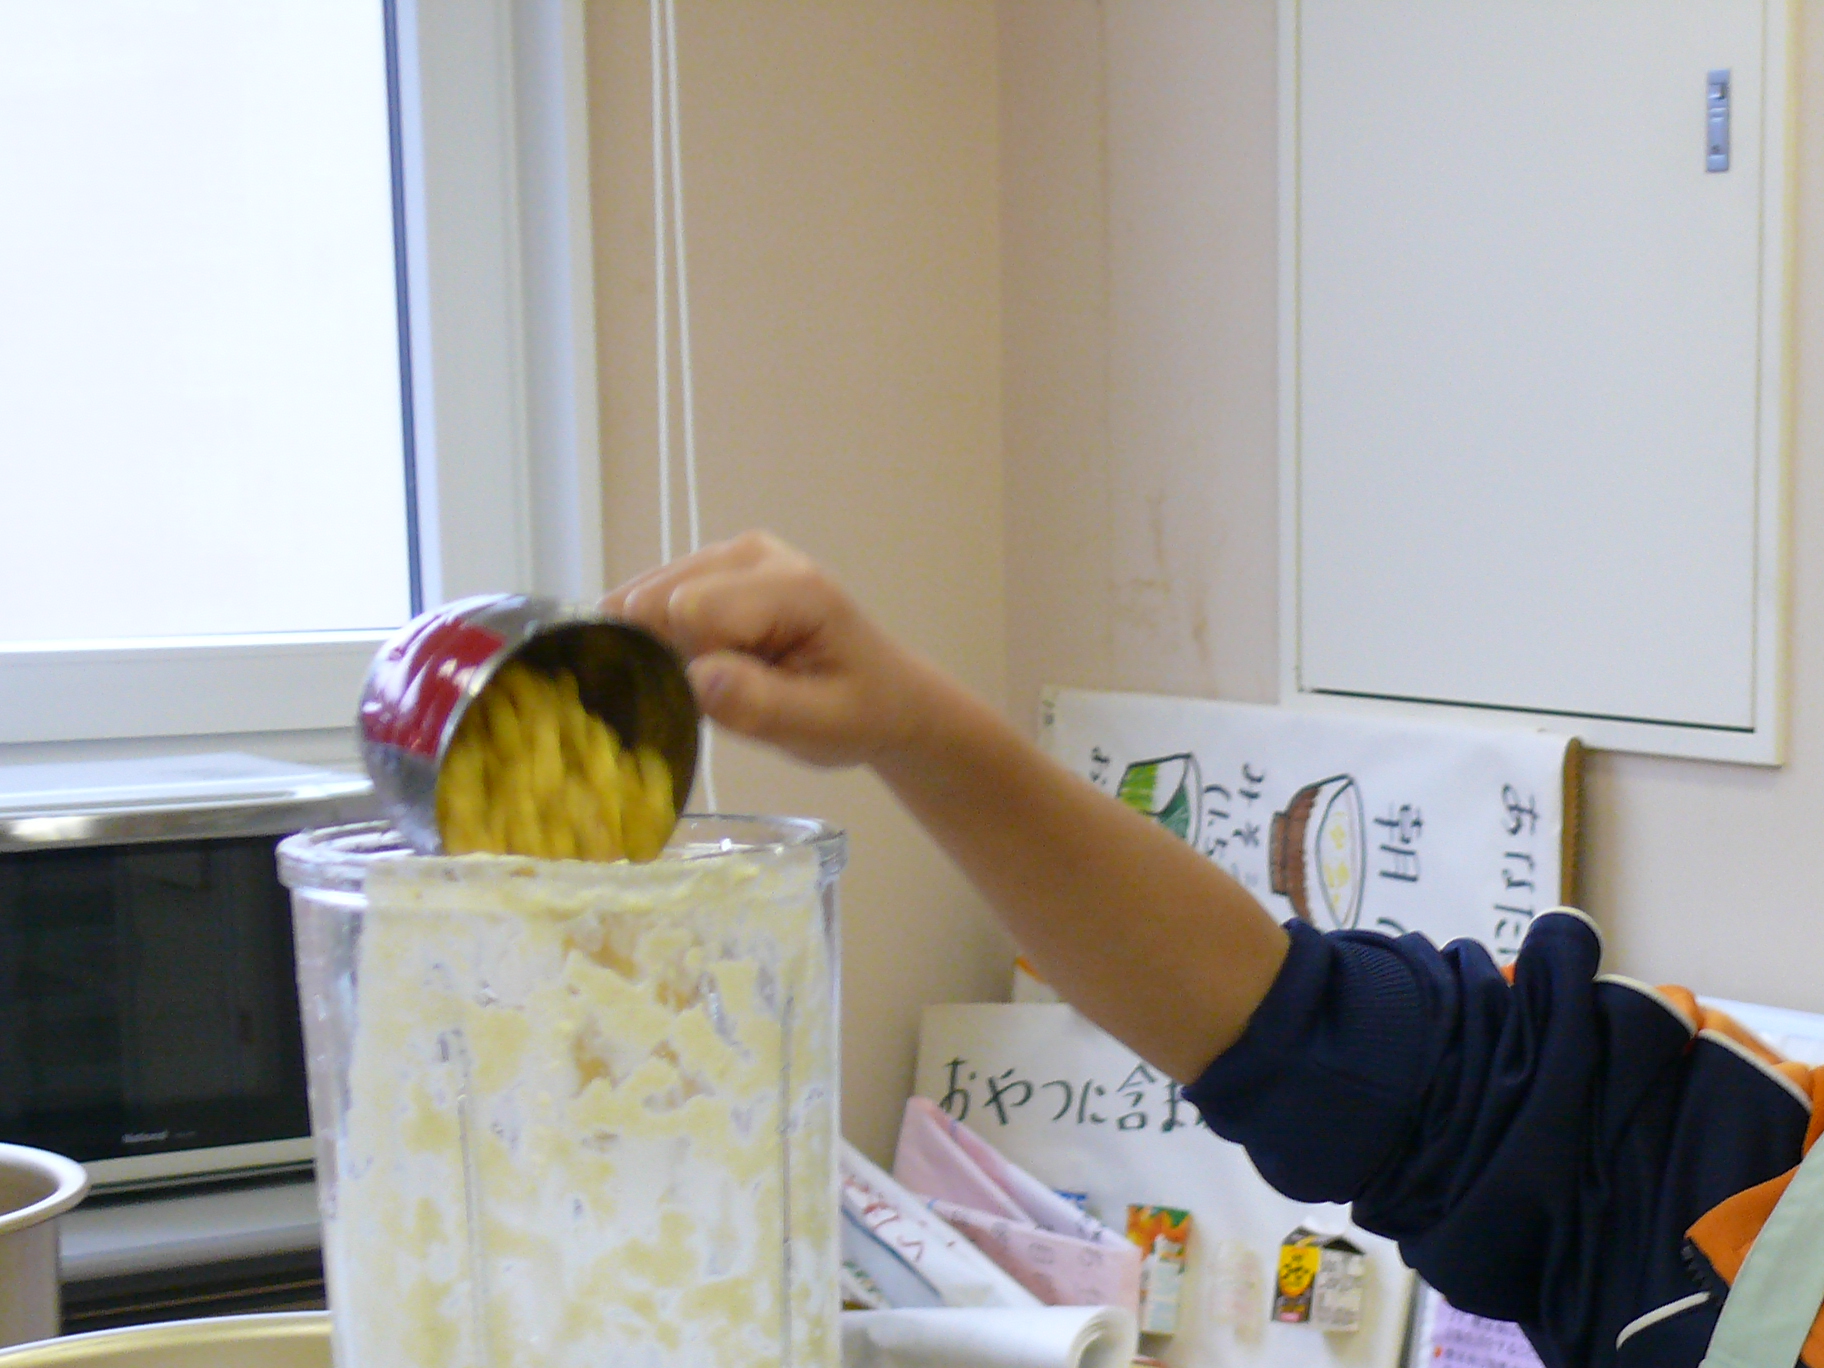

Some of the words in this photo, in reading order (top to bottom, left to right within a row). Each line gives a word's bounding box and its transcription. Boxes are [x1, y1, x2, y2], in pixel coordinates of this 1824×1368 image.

[938, 1055, 1207, 1133] おやつに含ま
